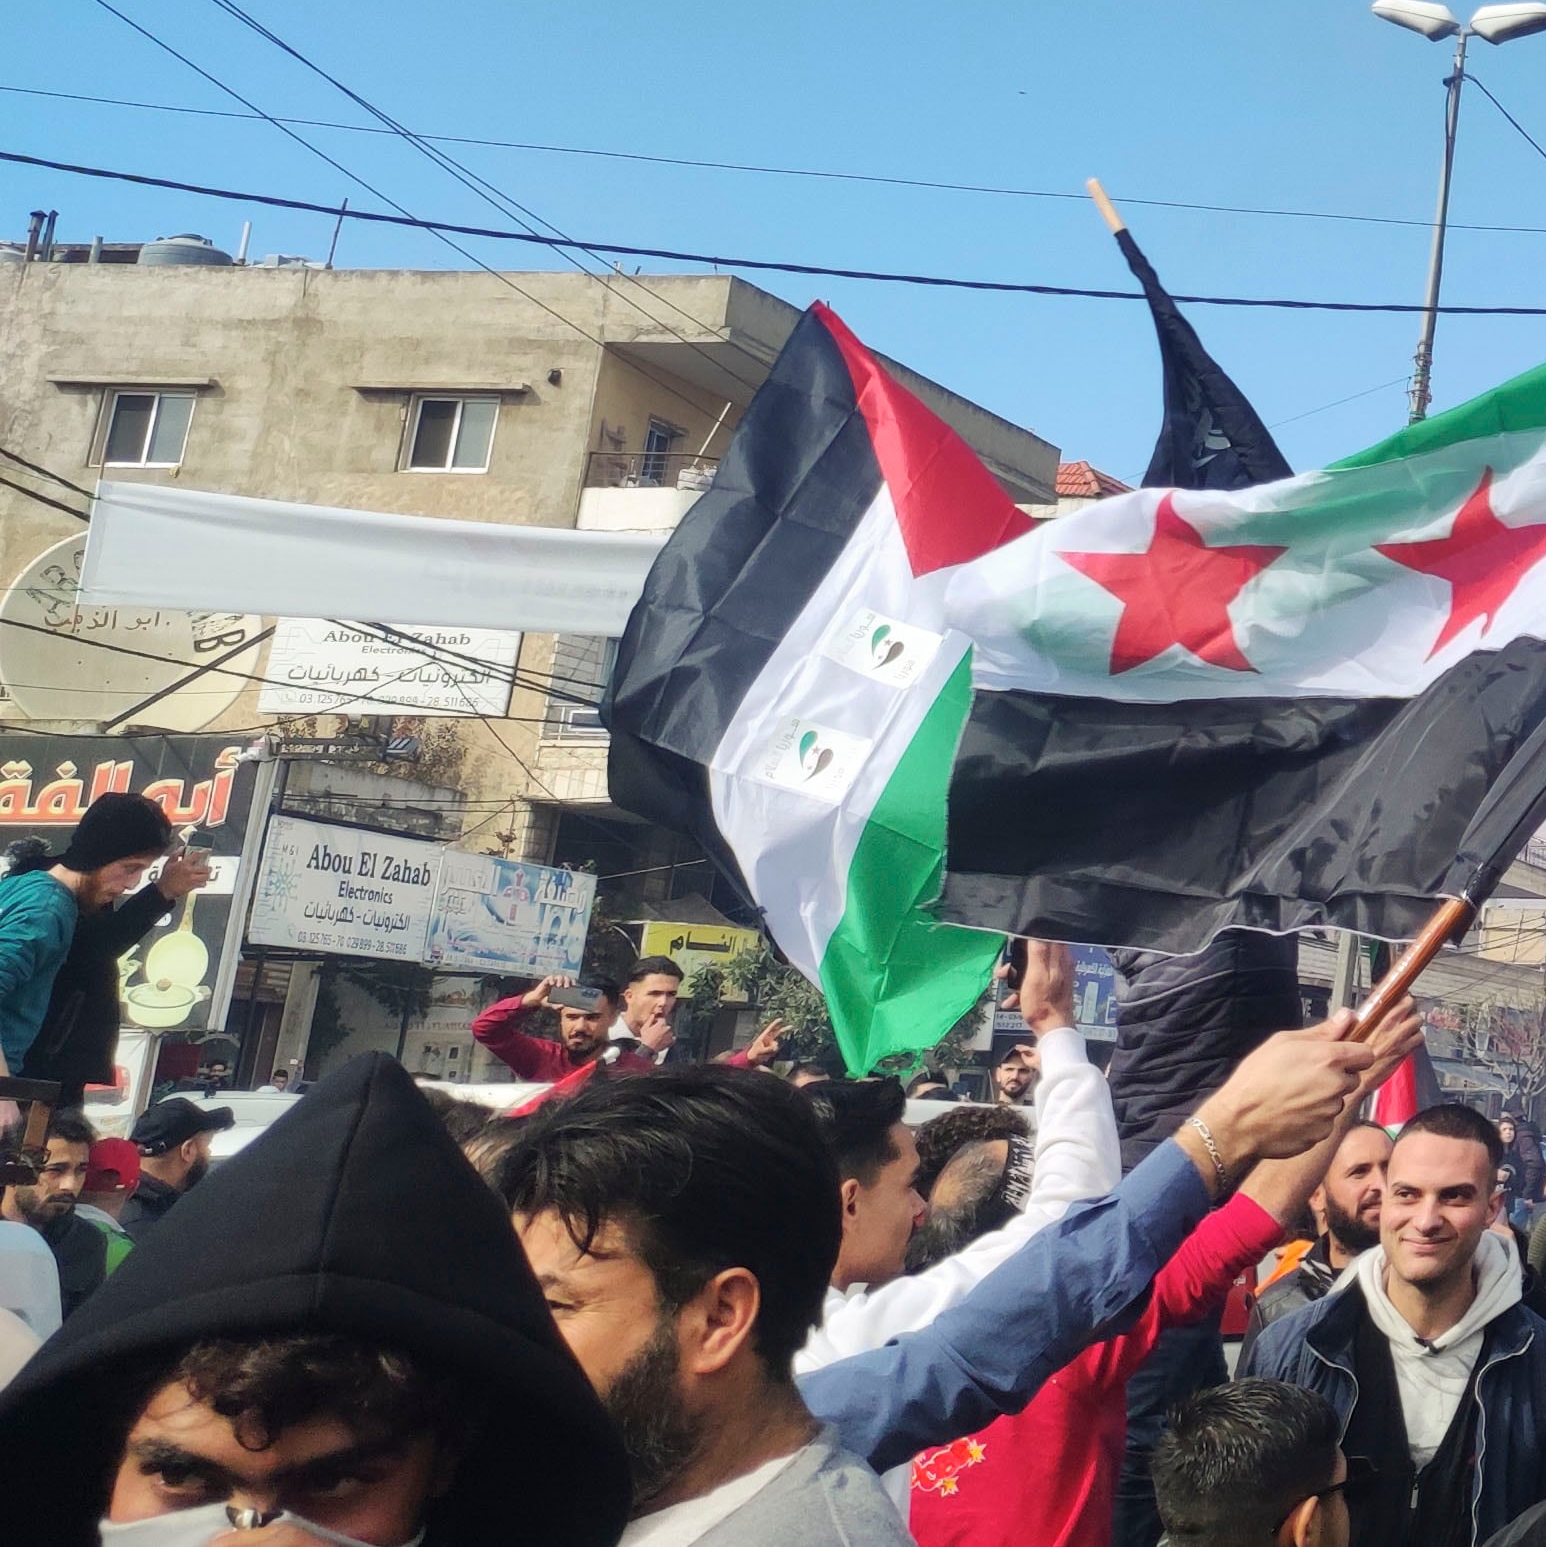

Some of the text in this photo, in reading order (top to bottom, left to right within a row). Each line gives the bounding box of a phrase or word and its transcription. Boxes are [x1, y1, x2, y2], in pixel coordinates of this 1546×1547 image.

[306, 843, 353, 875] Abou
[357, 851, 379, 879] El
[380, 854, 432, 887] Zahab
[337, 880, 394, 905] Electronics
[303, 901, 355, 927] كهربائيات
